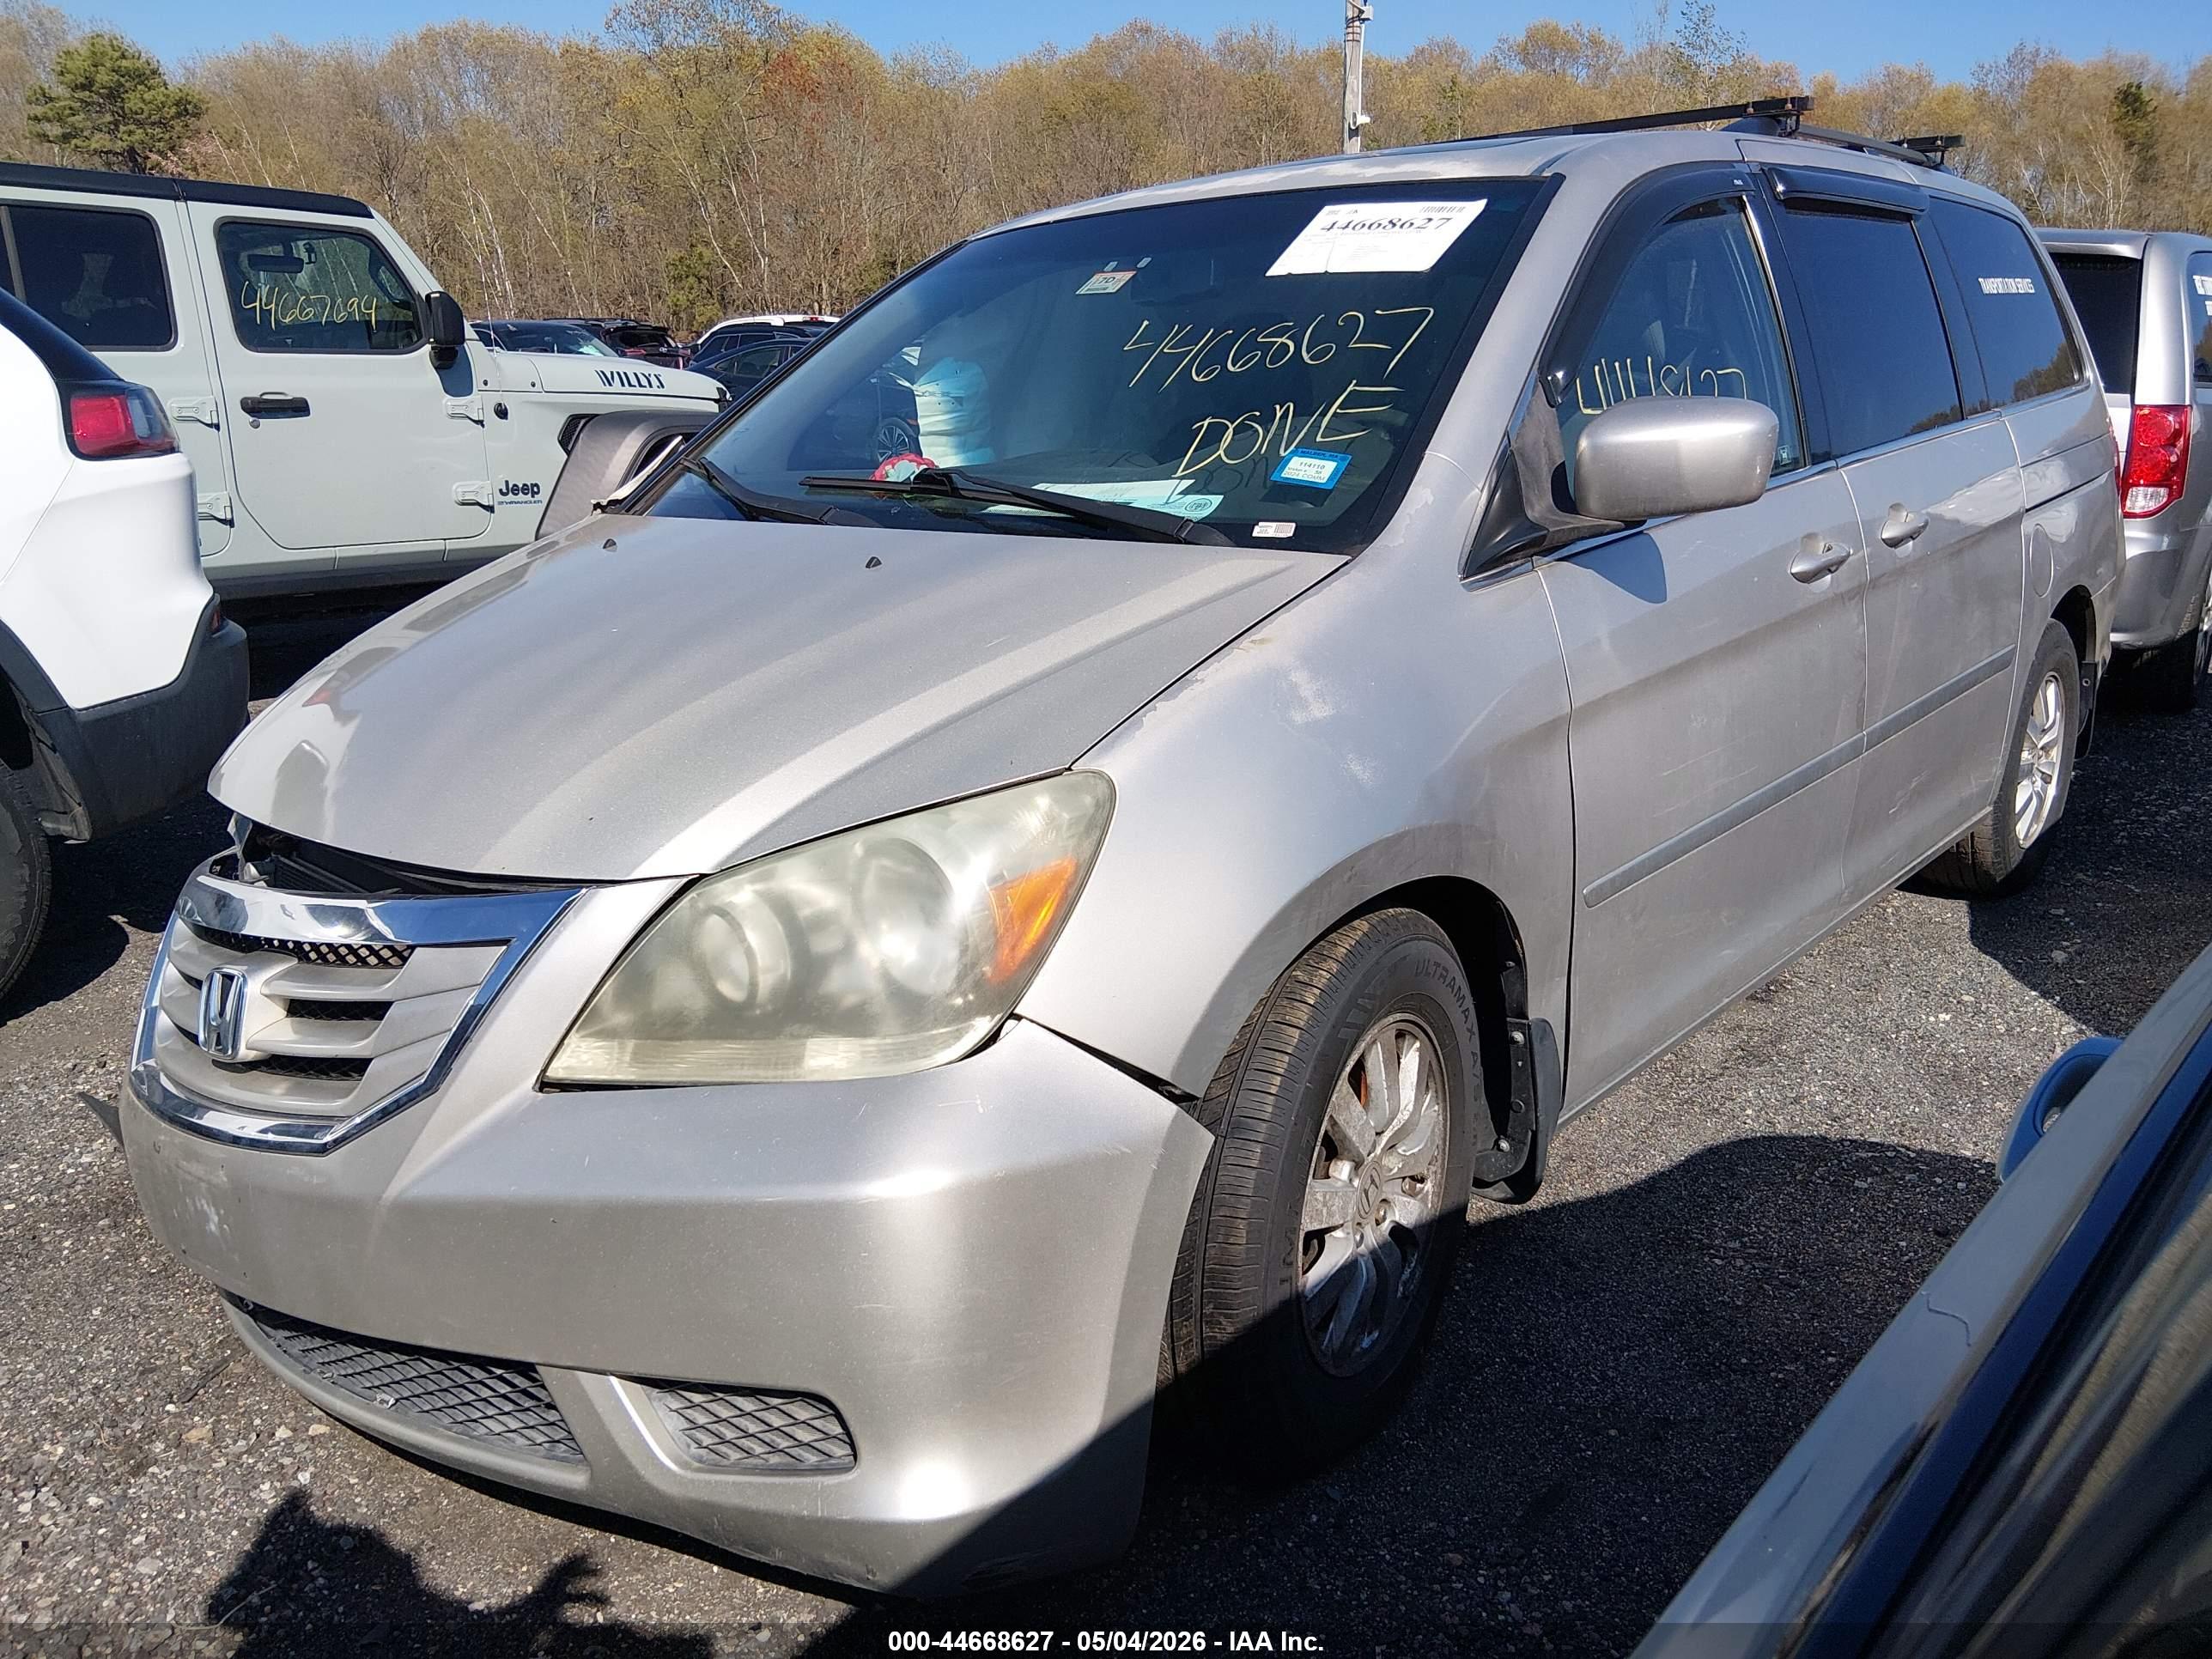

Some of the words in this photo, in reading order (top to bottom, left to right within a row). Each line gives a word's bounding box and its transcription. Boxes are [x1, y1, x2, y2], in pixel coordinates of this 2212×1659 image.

[1321, 217, 1454, 233] 44668627
[240, 281, 377, 332] 44667694
[1122, 307, 1435, 394] 44668627
[594, 369, 665, 390] WILLYS
[1170, 379, 1406, 478] DONE
[499, 480, 541, 498] Jeep
[1414, 957, 1476, 1043] ULTRAMAX
